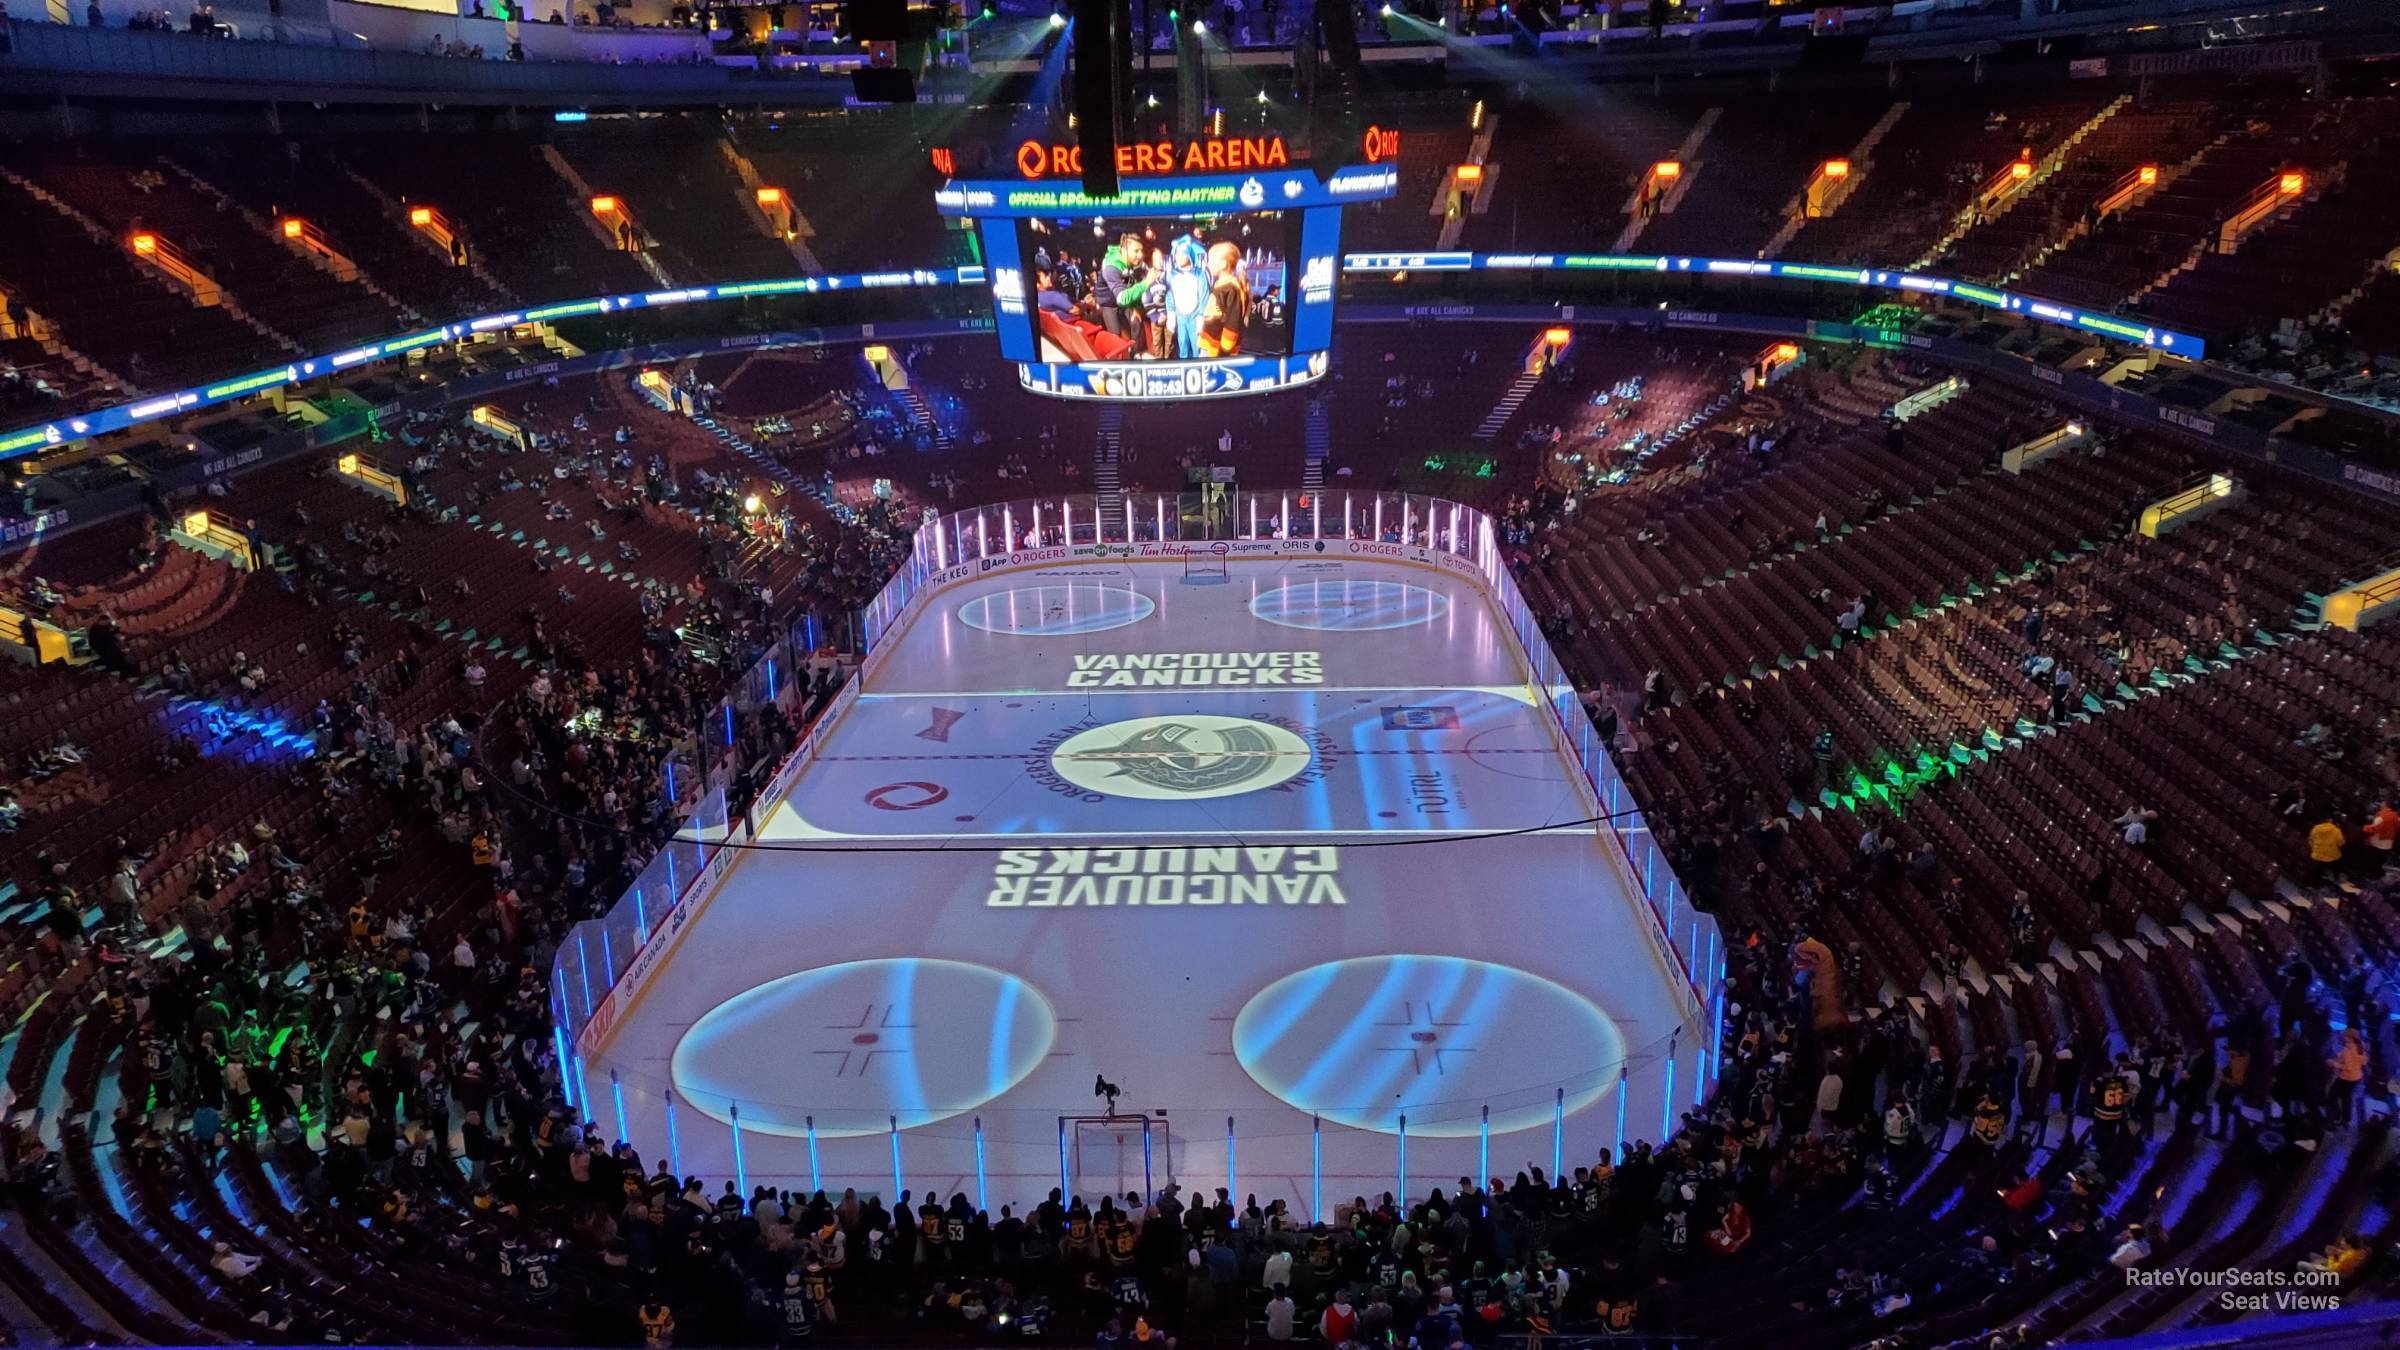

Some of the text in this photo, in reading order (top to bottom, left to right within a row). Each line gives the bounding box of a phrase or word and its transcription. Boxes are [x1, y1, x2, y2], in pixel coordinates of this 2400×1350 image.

[1053, 137, 1287, 173] ROERS ARENA
[1009, 191, 1057, 207] OFFICIAL
[1172, 186, 1236, 203] PARTNER
[1127, 370, 1142, 395] 0
[1186, 368, 1200, 394] 0
[1139, 543, 1160, 557] Tim
[1231, 542, 1272, 552] Supreme
[1282, 540, 1310, 550] ORIS
[1362, 543, 1403, 557] ROGERS
[1024, 549, 1066, 563] ROGERS
[932, 565, 968, 588] THE KEG
[1453, 559, 1477, 576] TOYOTA
[1073, 651, 1322, 670] VANCOUVER
[1067, 667, 1324, 687] CANUCKS
[995, 845, 1338, 874] CANUCKS
[987, 874, 1348, 907] VANCOUVER
[634, 935, 667, 981] AIR CANADA
[1653, 922, 1680, 986] GATORADE
[948, 1224, 965, 1242] 53
[1380, 1271, 1397, 1288] 53
